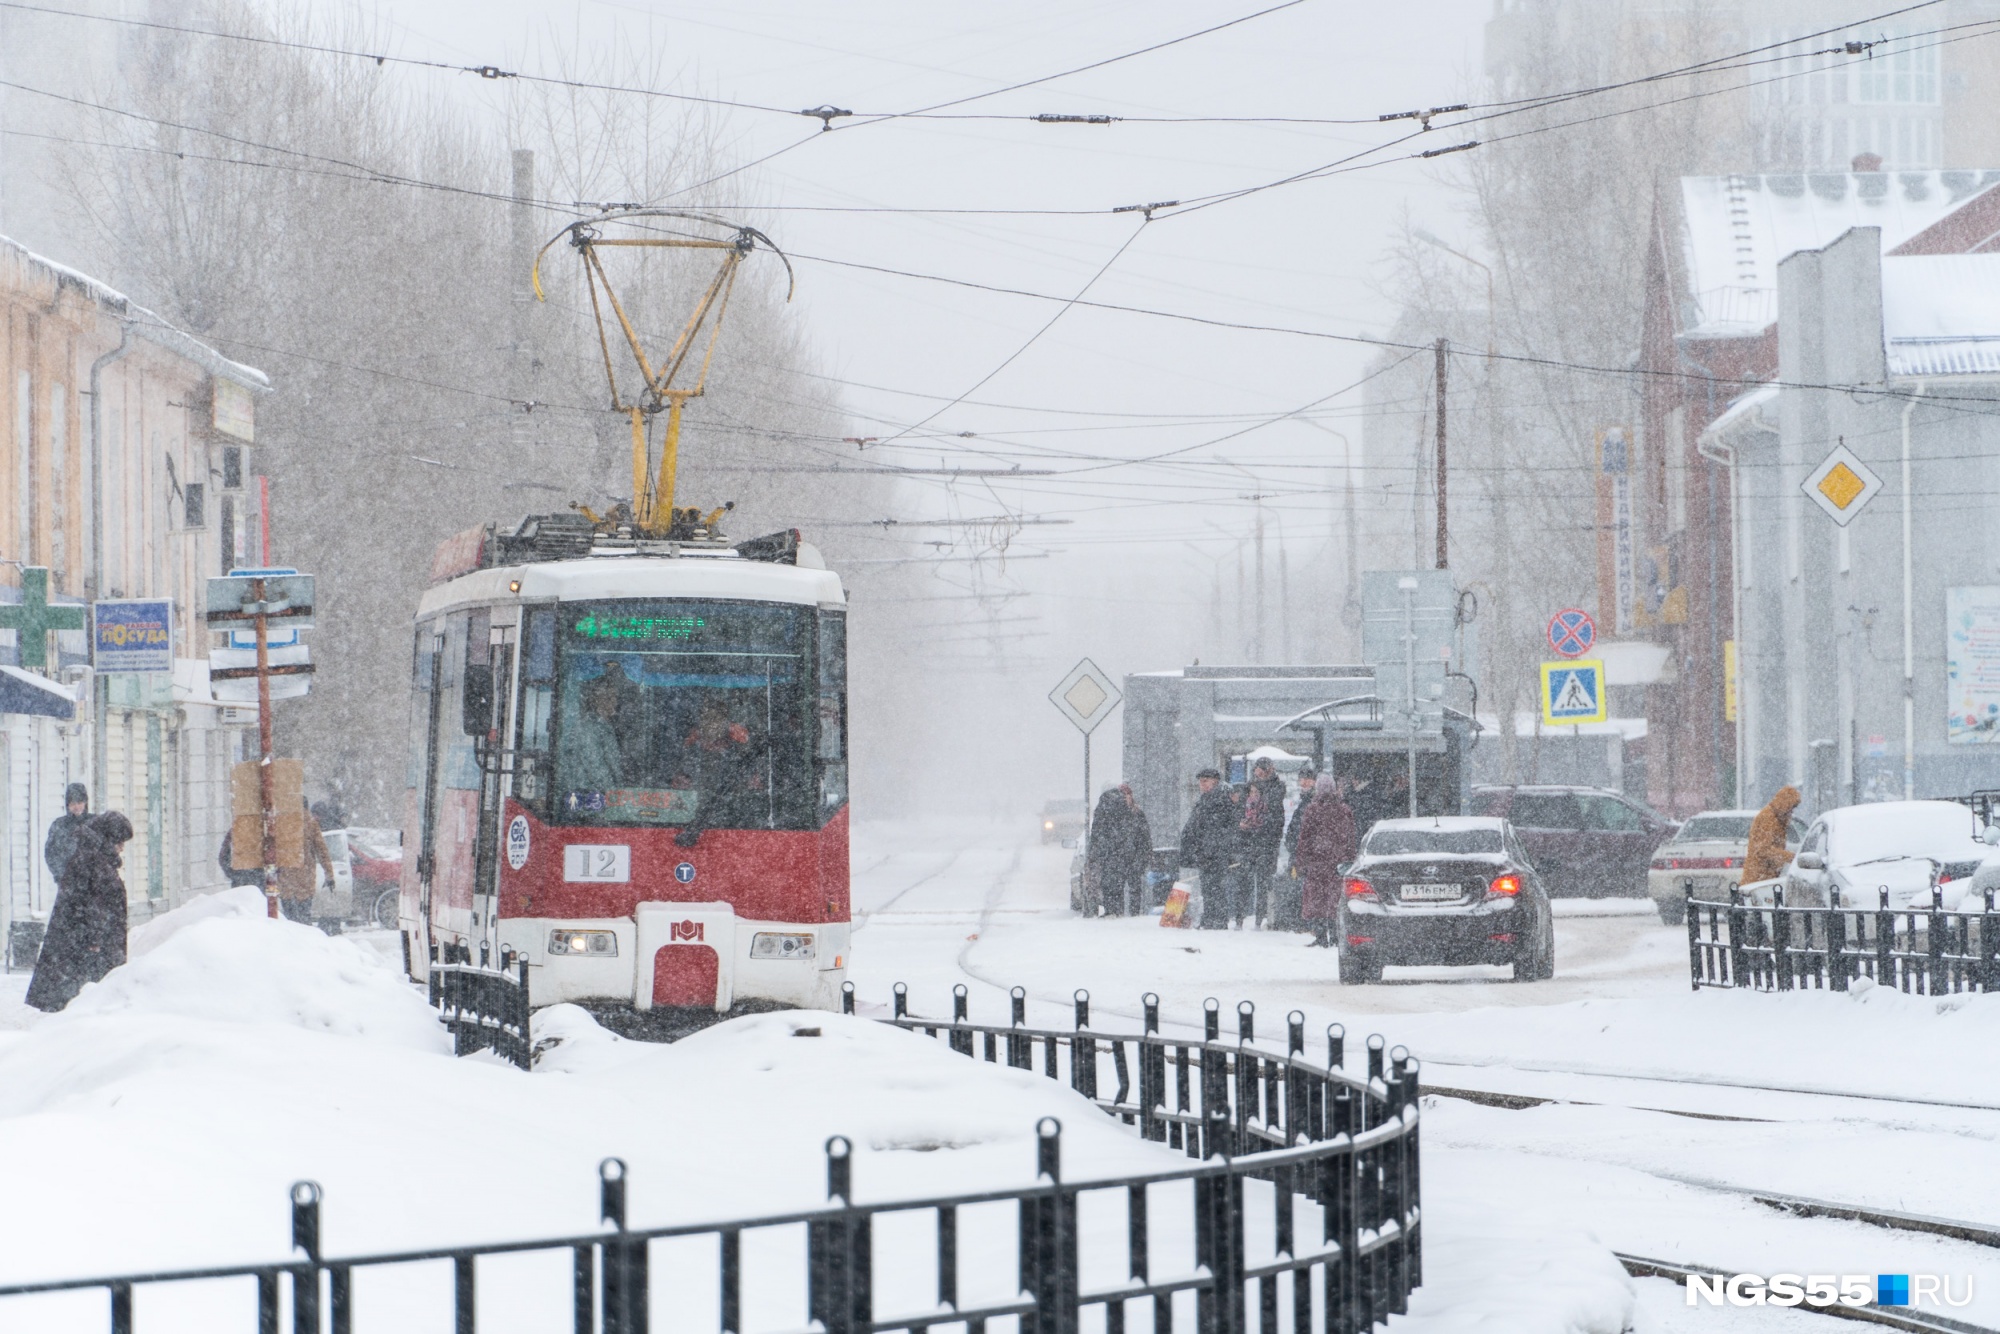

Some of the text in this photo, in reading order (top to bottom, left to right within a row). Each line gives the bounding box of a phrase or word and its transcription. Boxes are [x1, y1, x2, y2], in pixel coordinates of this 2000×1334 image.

[1617, 478, 1632, 632] НЕДВИЖИМОСТЬ
[101, 624, 168, 646] ПОСУДА
[575, 613, 598, 639] 4
[579, 850, 616, 878] 12
